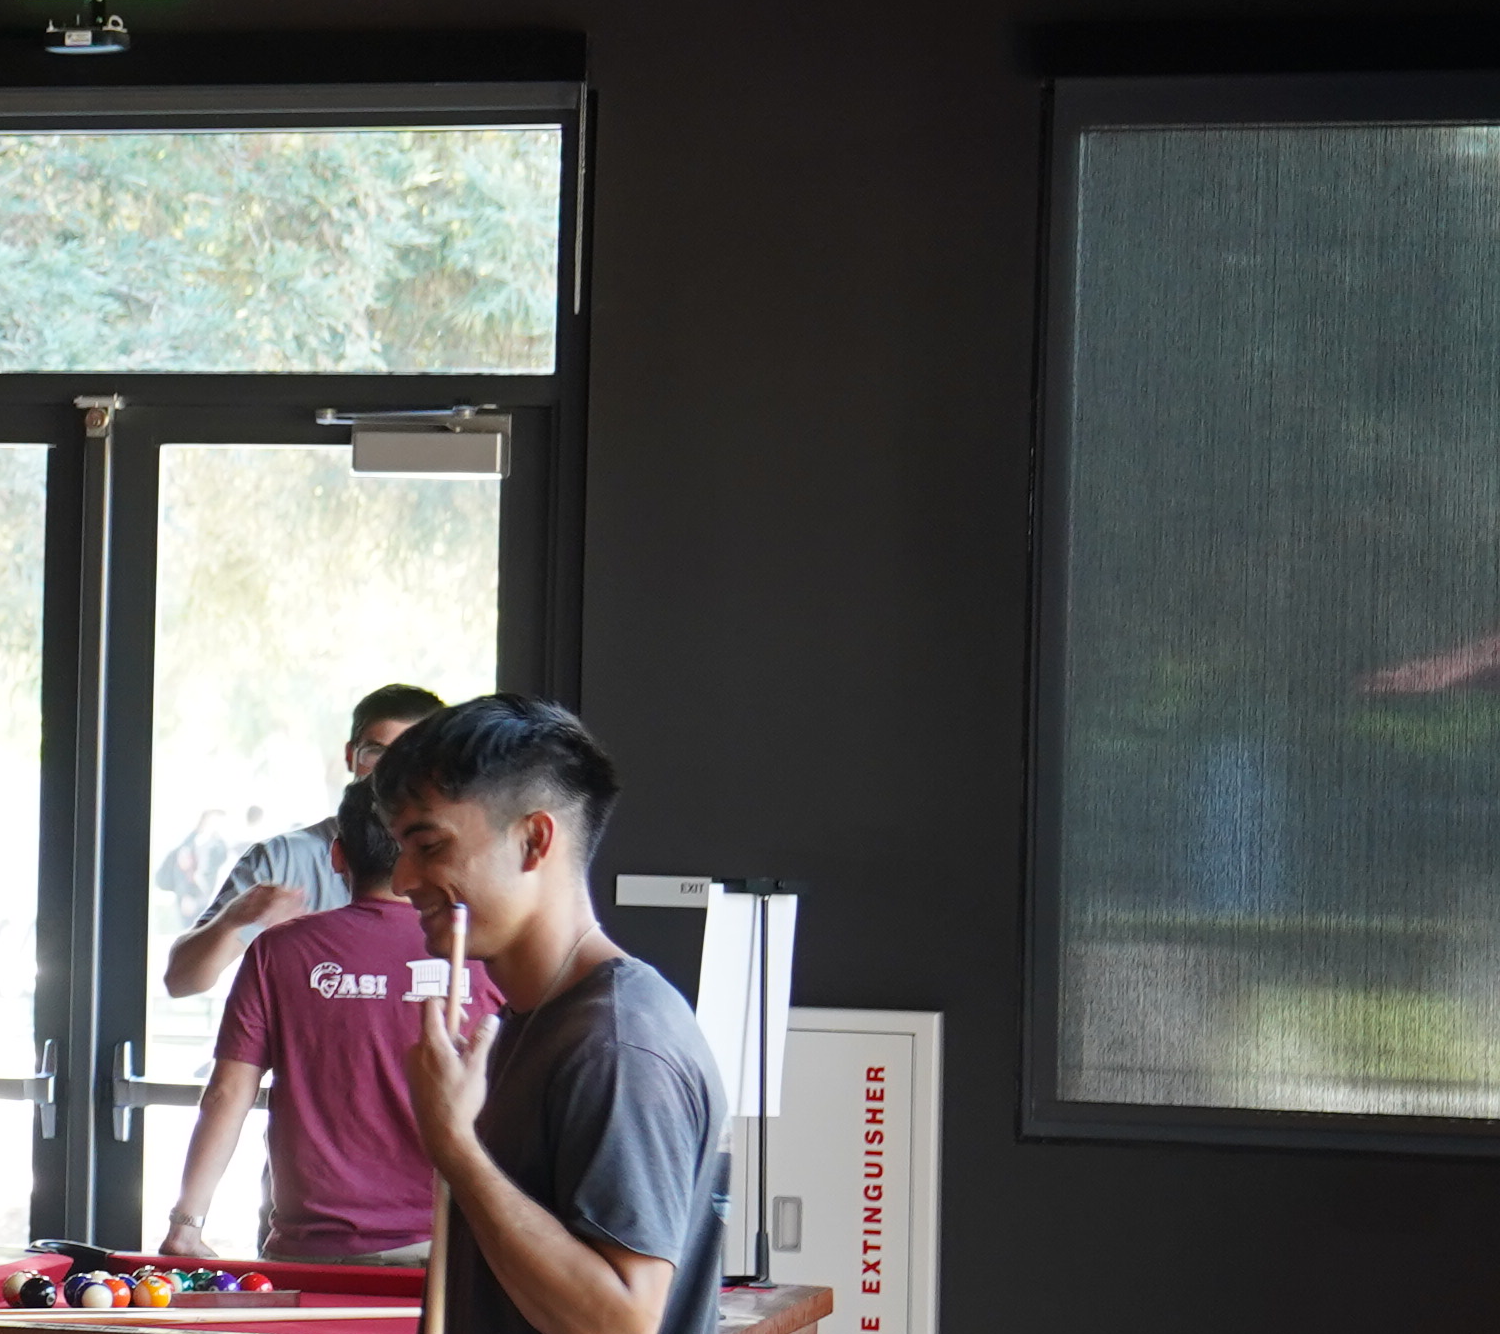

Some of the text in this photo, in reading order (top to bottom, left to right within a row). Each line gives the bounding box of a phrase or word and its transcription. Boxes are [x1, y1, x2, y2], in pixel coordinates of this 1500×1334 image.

[680, 882, 704, 894] EXIT
[338, 974, 388, 995] ASI
[861, 1065, 886, 1295] EXTINGUISHER
